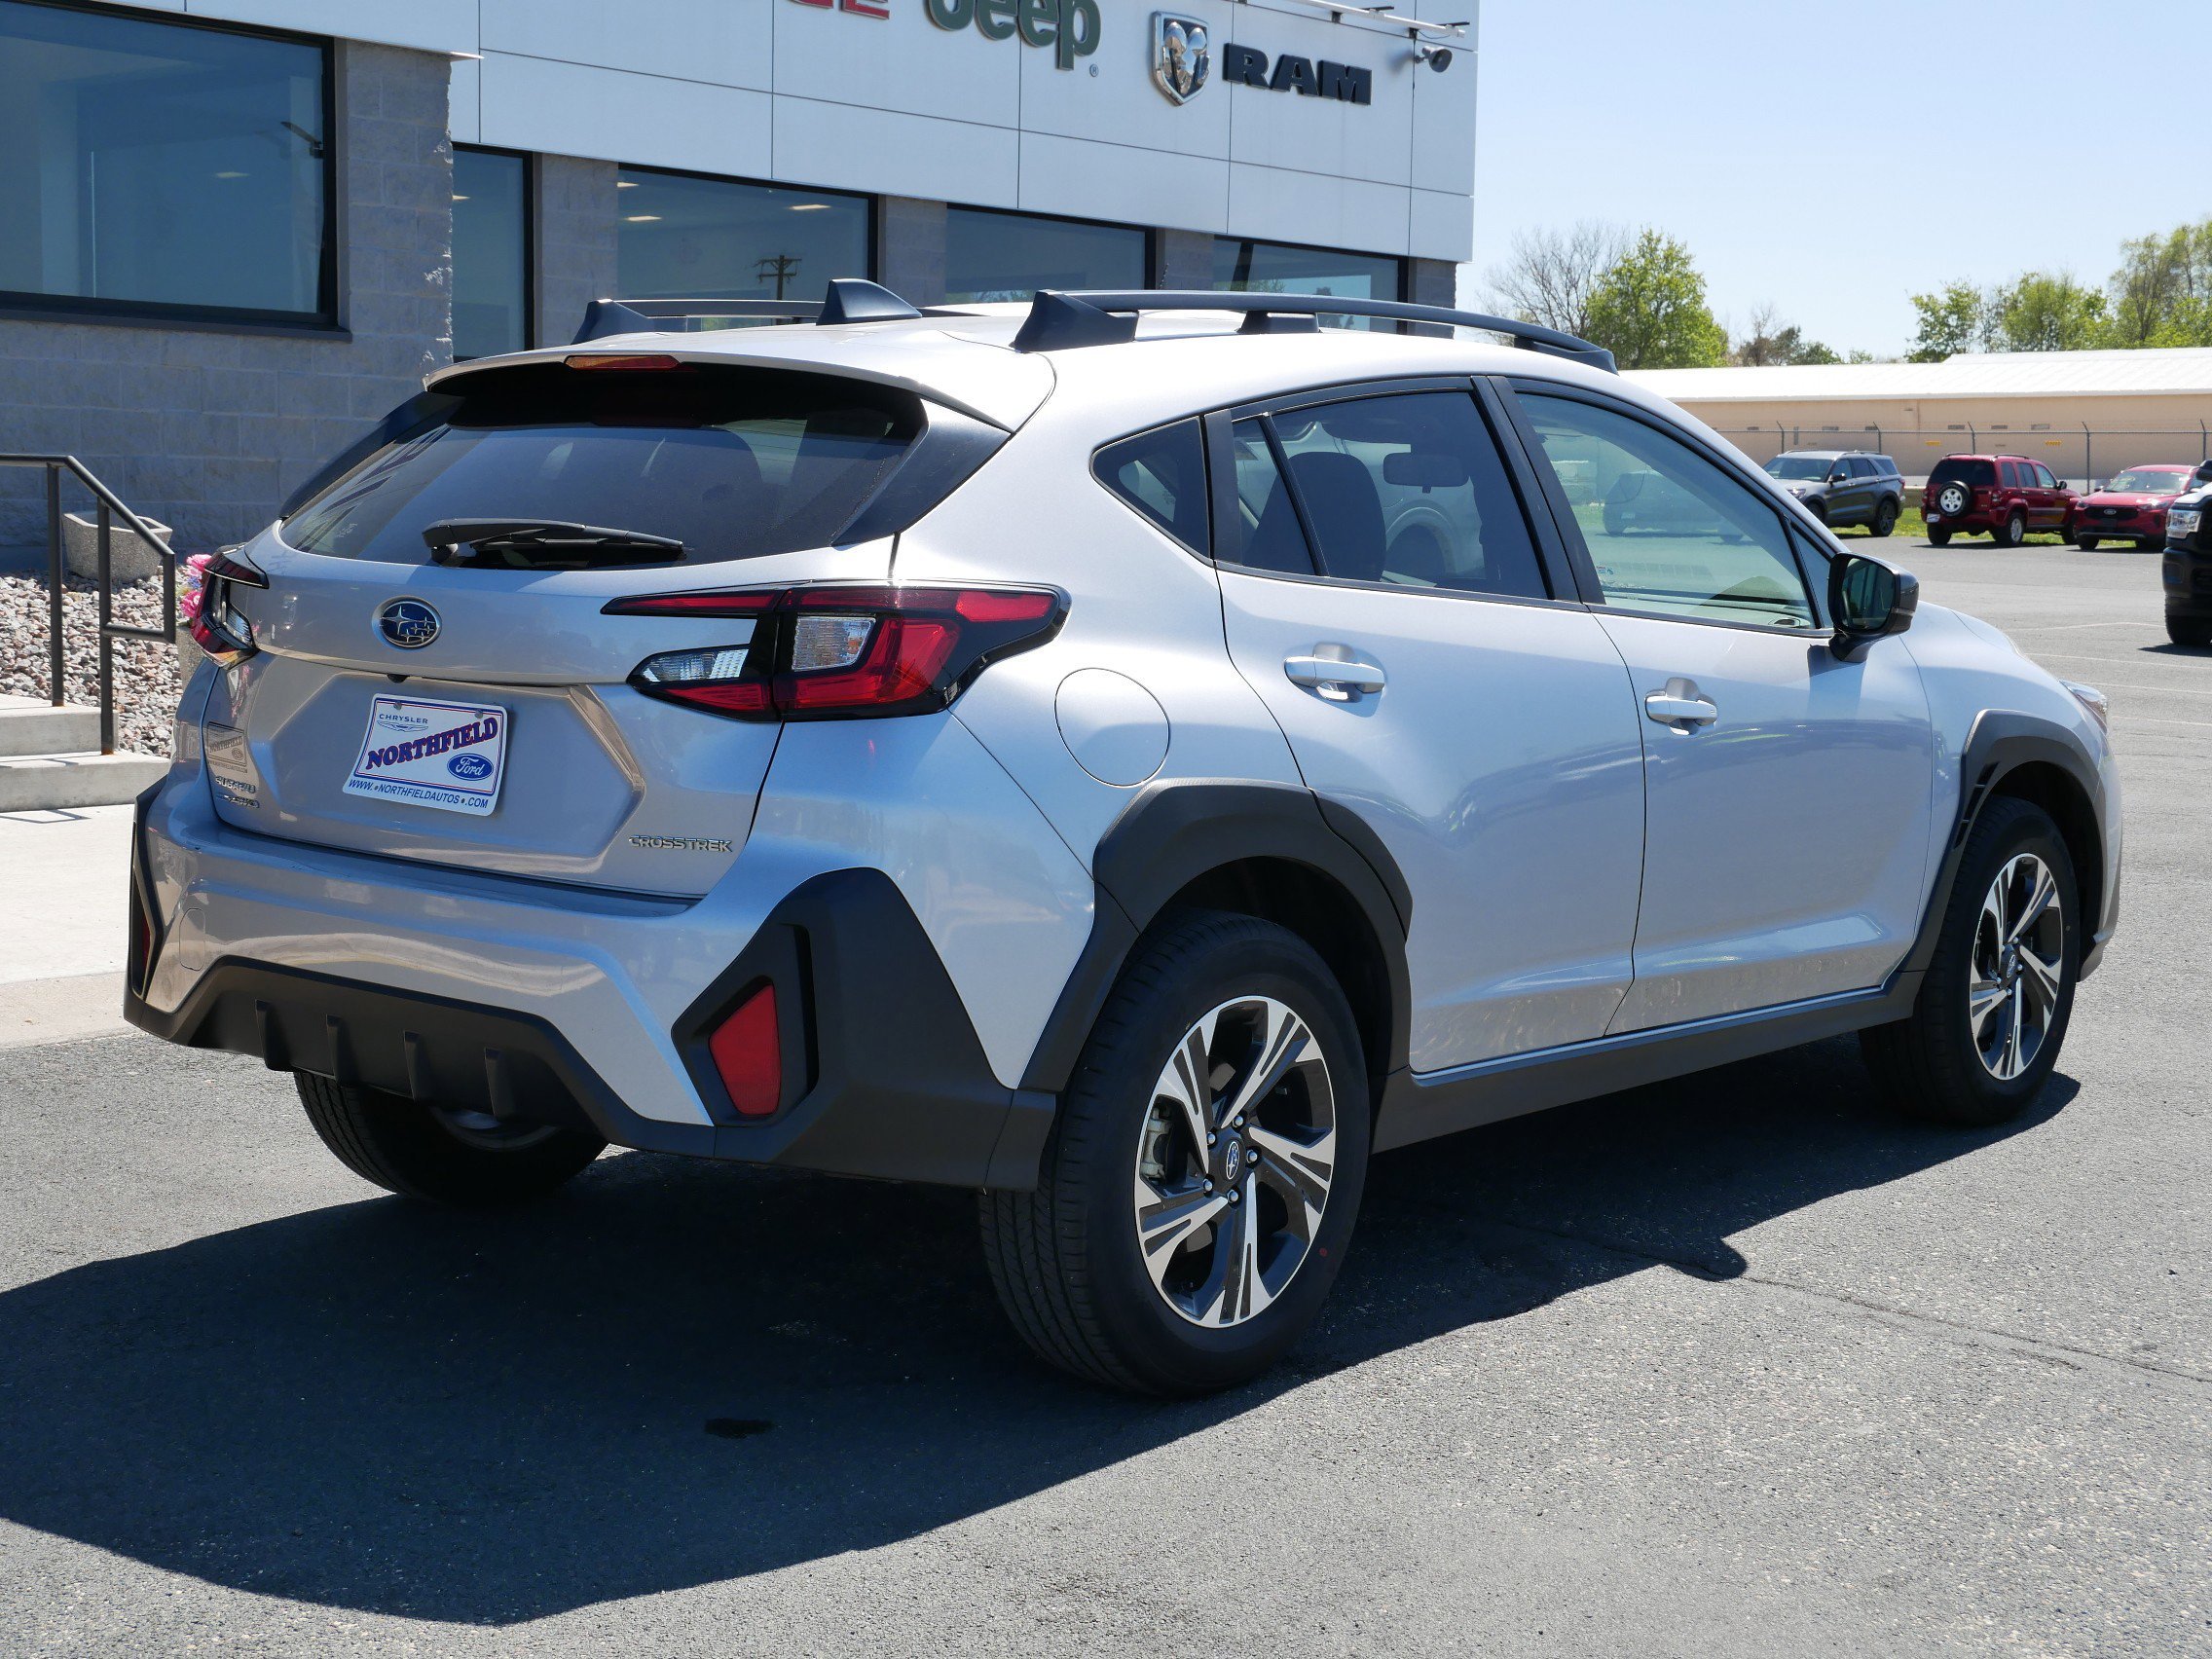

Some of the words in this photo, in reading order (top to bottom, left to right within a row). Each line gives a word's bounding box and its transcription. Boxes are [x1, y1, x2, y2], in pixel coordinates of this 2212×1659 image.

[1222, 42, 1373, 106] RAM
[379, 713, 428, 724] CHRYSLER
[365, 717, 498, 770] NORTHFIELD
[455, 756, 484, 776] Ford
[628, 834, 733, 853] CROSSTREK
